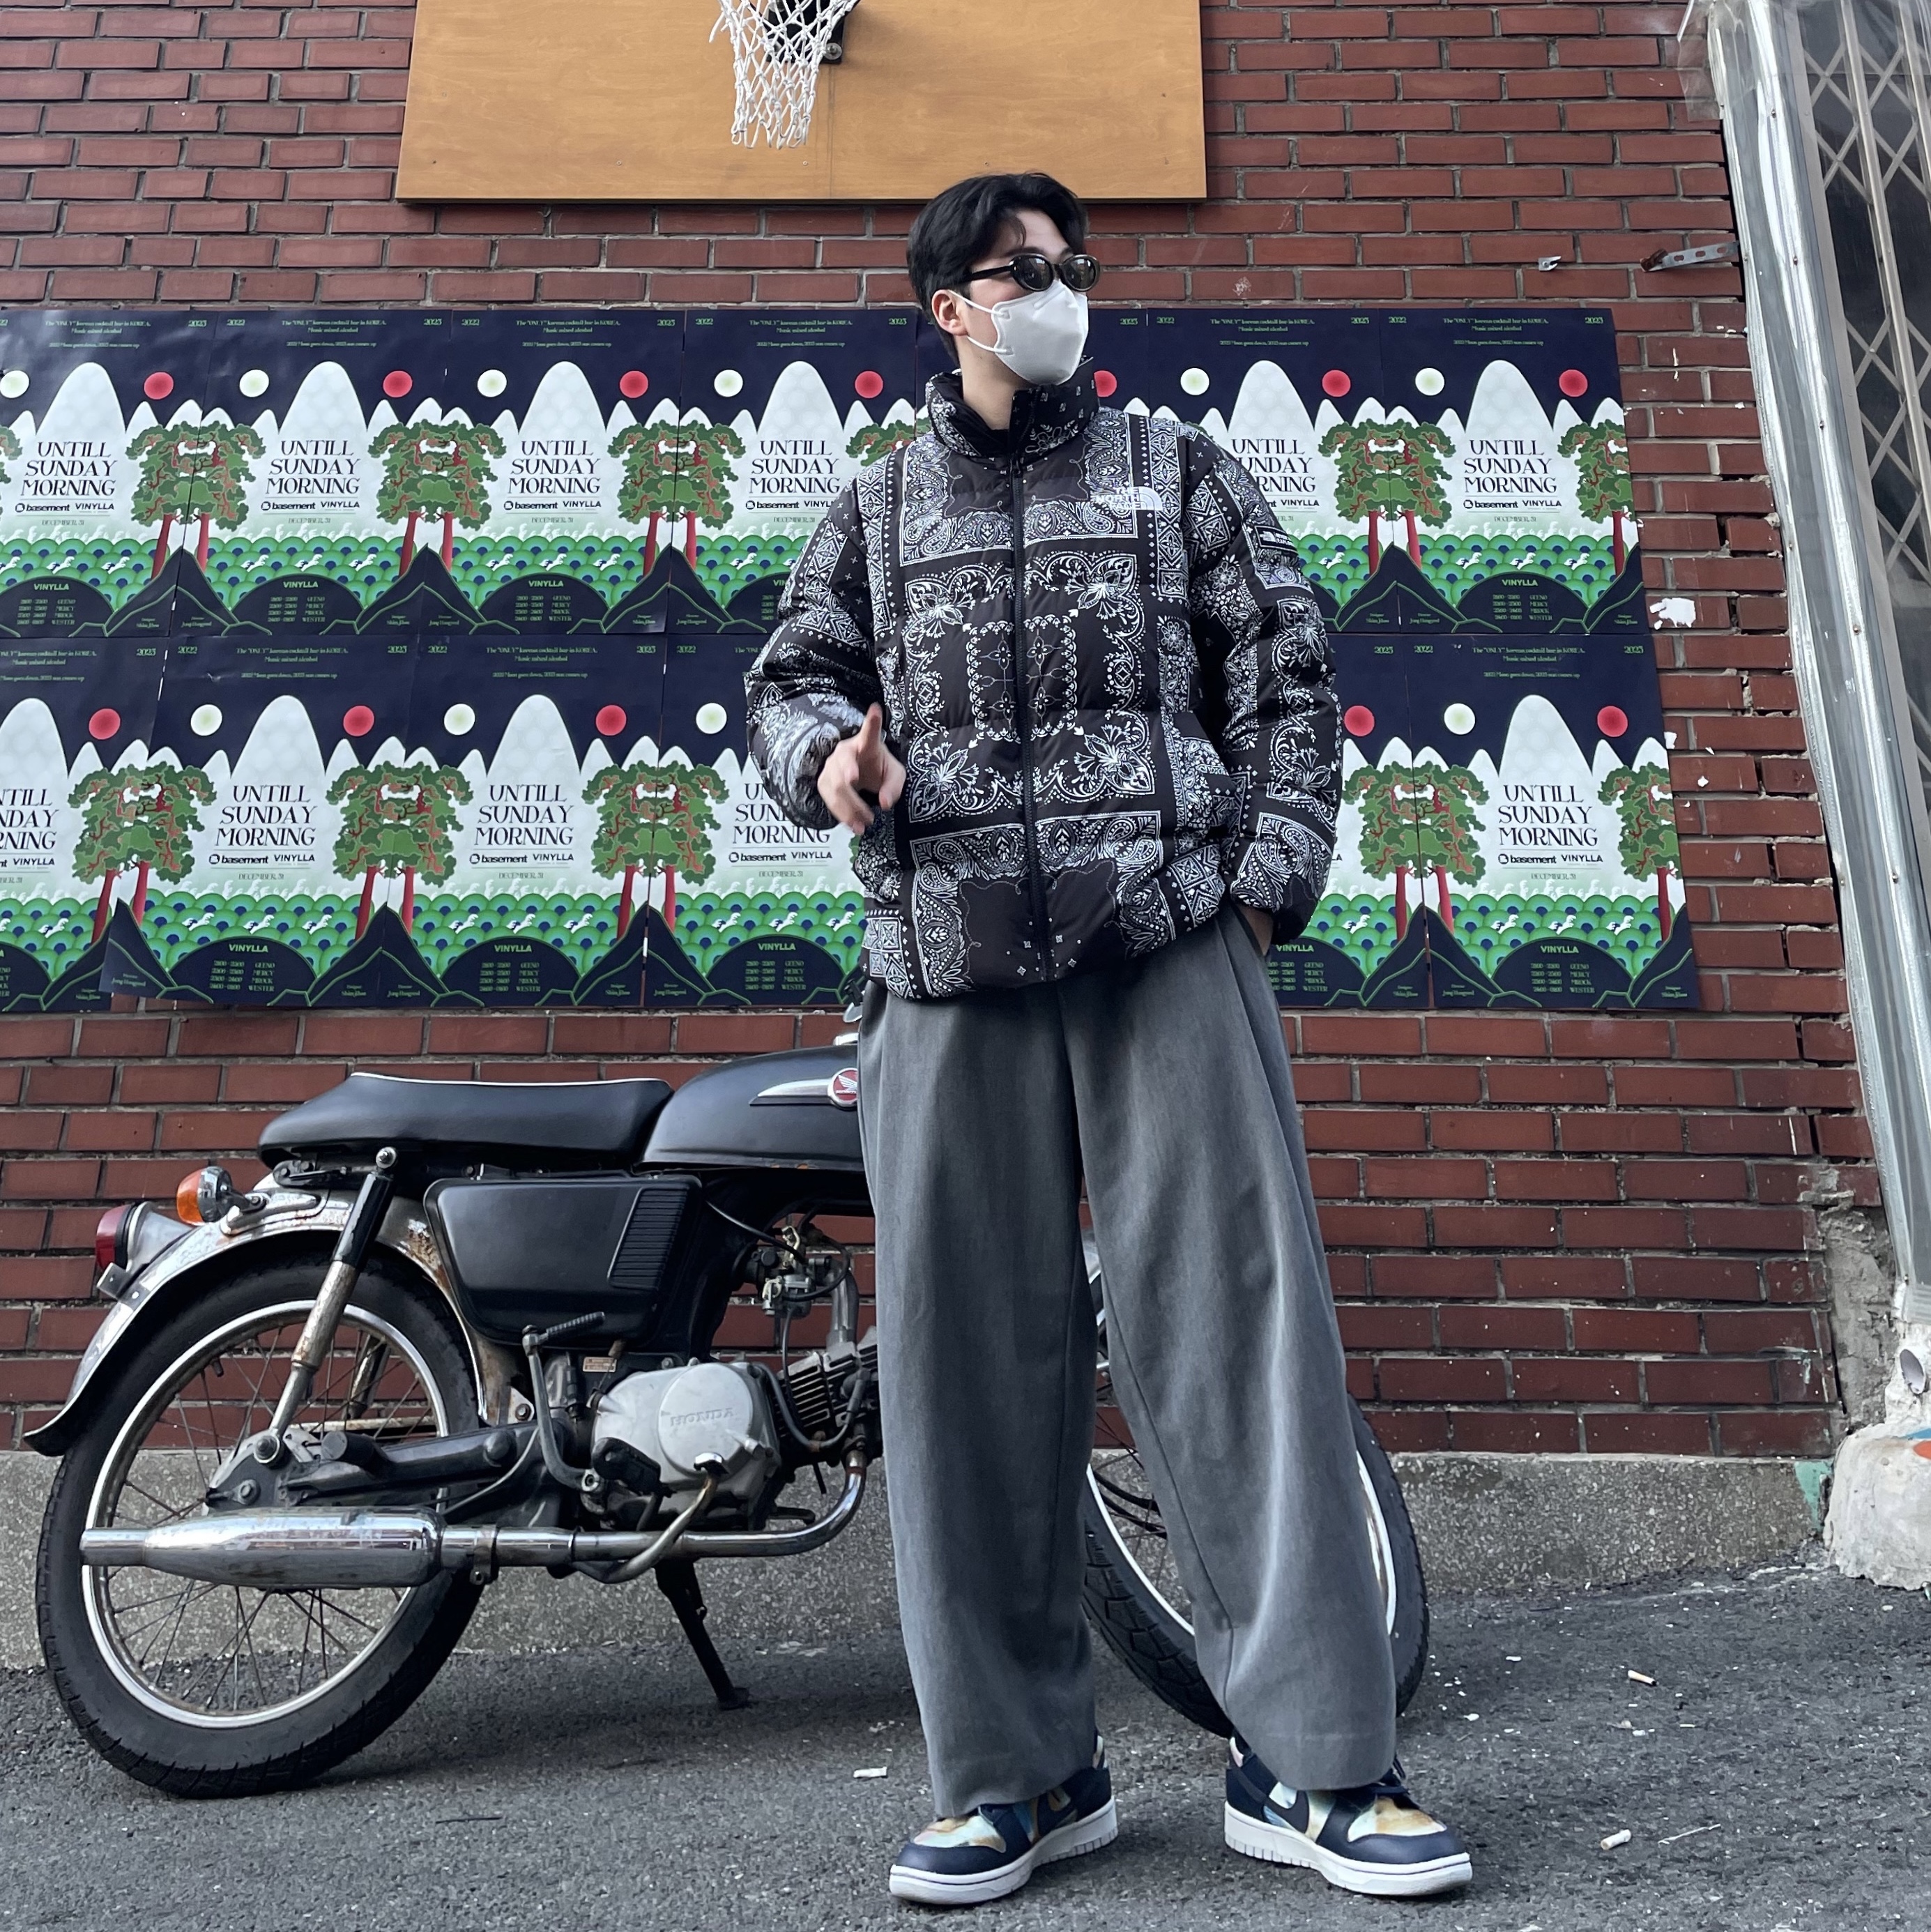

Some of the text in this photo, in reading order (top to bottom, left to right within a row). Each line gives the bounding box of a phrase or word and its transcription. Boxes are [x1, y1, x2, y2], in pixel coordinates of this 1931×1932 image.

[38, 441, 111, 457] UNTILL
[282, 440, 353, 455] UNTILL
[522, 441, 593, 455] UNTILL
[761, 440, 832, 455] UNTILL
[1232, 439, 1304, 454] UNTILL
[1470, 440, 1544, 455] UNTILL
[25, 460, 116, 476] SUNDAY
[269, 459, 360, 474] SUNDAY
[511, 459, 600, 474] SUNDAY
[751, 459, 839, 474] SUNDAY
[1239, 457, 1313, 473] UNDAY
[1464, 458, 1551, 473] SUNDAY
[21, 480, 116, 496] MORNING
[266, 478, 360, 494] MORNING
[509, 478, 600, 493] MORNING
[750, 478, 840, 493] MORNING
[1256, 476, 1316, 492] RNING
[1465, 477, 1557, 493] MORNING
[26, 503, 70, 512] basement
[514, 501, 558, 510] basement
[1474, 500, 1519, 508] basement
[234, 785, 310, 802] UNTILL
[490, 784, 566, 802] UNTILL
[1504, 785, 1583, 803] UNTILL
[220, 807, 316, 823] SUNDAY
[478, 806, 573, 823] SUNDAY
[1498, 806, 1592, 823] SUNDAY
[216, 828, 315, 846] MORNING
[475, 828, 572, 845] MORNING
[733, 825, 830, 844] MORNING
[1499, 828, 1597, 846] MORNING
[13, 858, 55, 866] VINYLLA
[221, 853, 315, 864] basement VINYLLA
[481, 854, 528, 863] basement
[740, 853, 787, 862] basement
[1510, 854, 1604, 864] basement VINYLLA
[229, 943, 268, 953] VINYLLA
[494, 944, 533, 952] VINYLLA
[758, 943, 796, 951] VINYLLA
[1275, 944, 1315, 952] VINYLLA
[1540, 945, 1580, 954] VINYLLA
